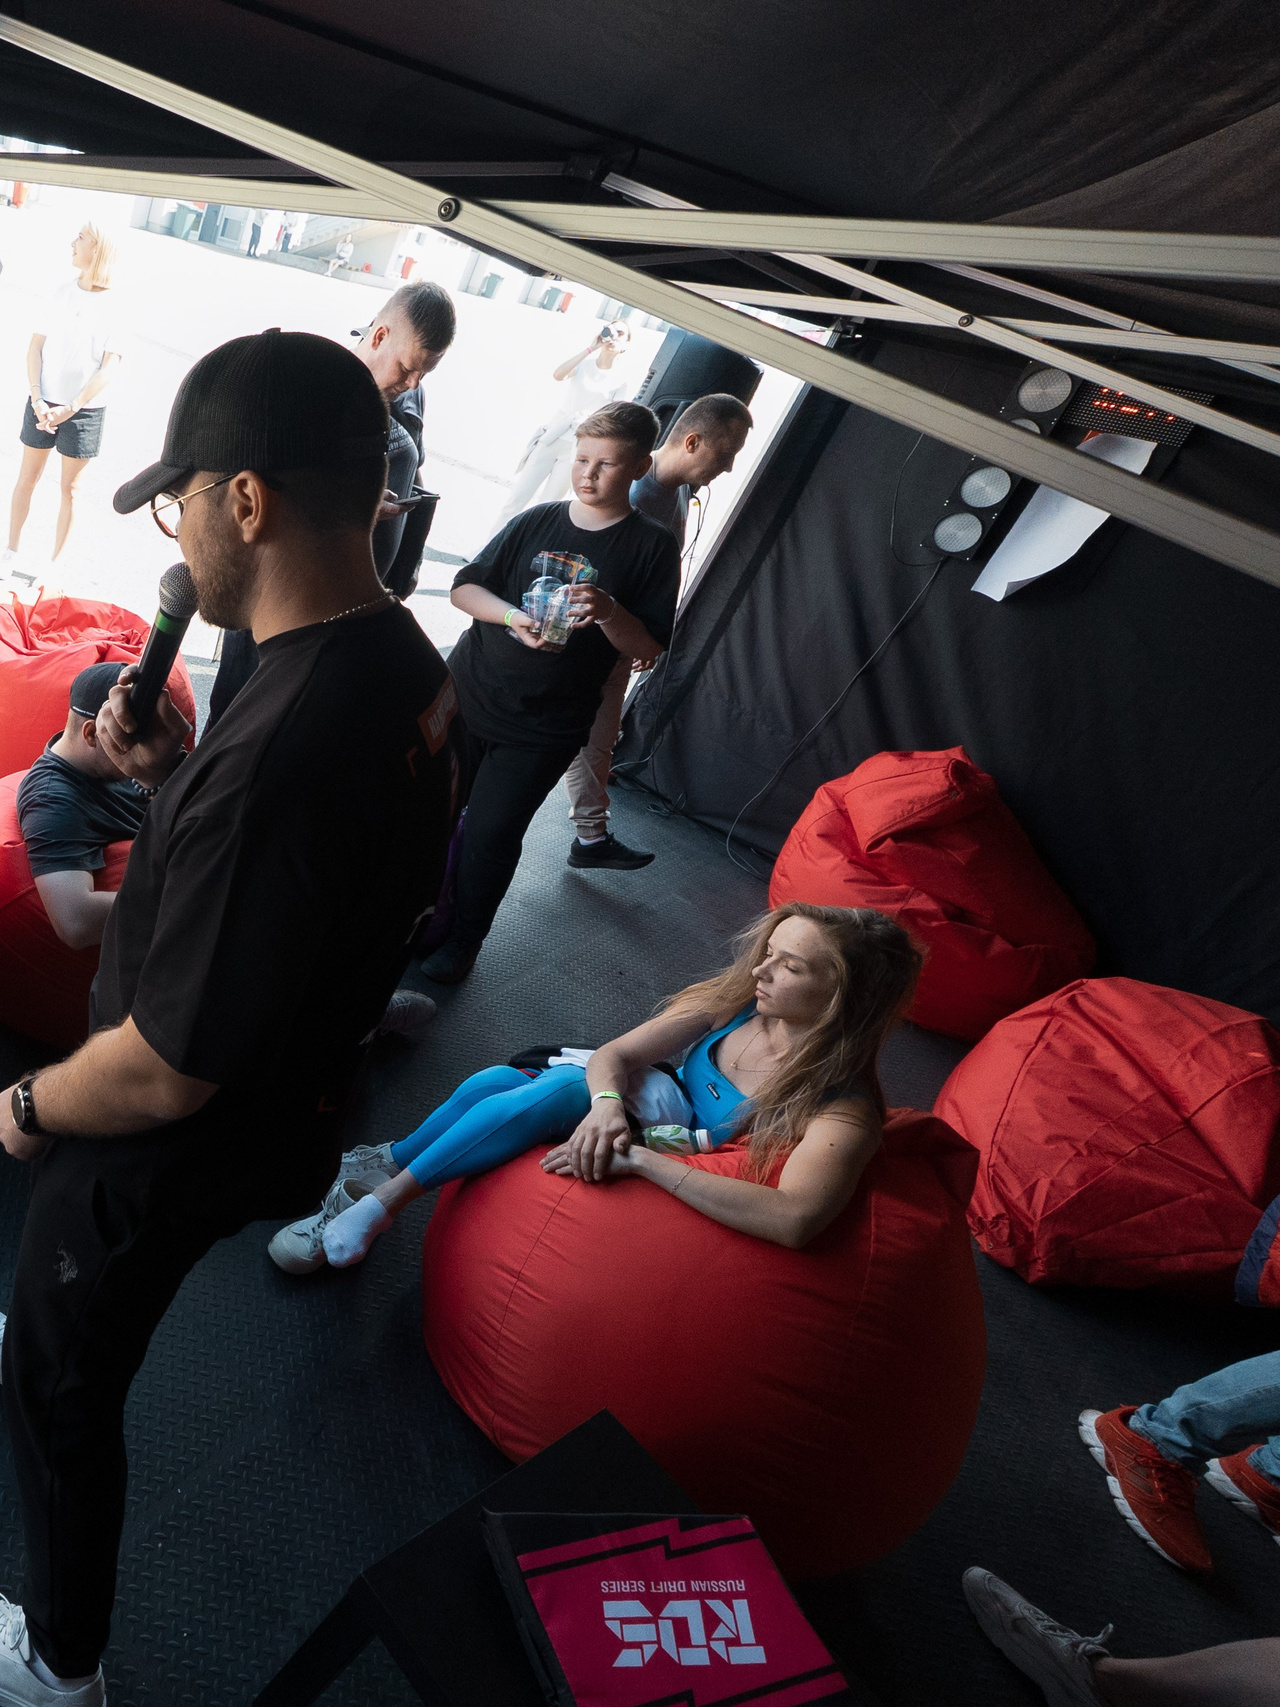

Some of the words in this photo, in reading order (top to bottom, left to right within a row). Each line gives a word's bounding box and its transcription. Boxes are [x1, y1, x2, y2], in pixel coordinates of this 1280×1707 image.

[600, 1580, 646, 1593] SERIES
[650, 1580, 687, 1593] DRIFT
[690, 1579, 746, 1592] RUSSIAN
